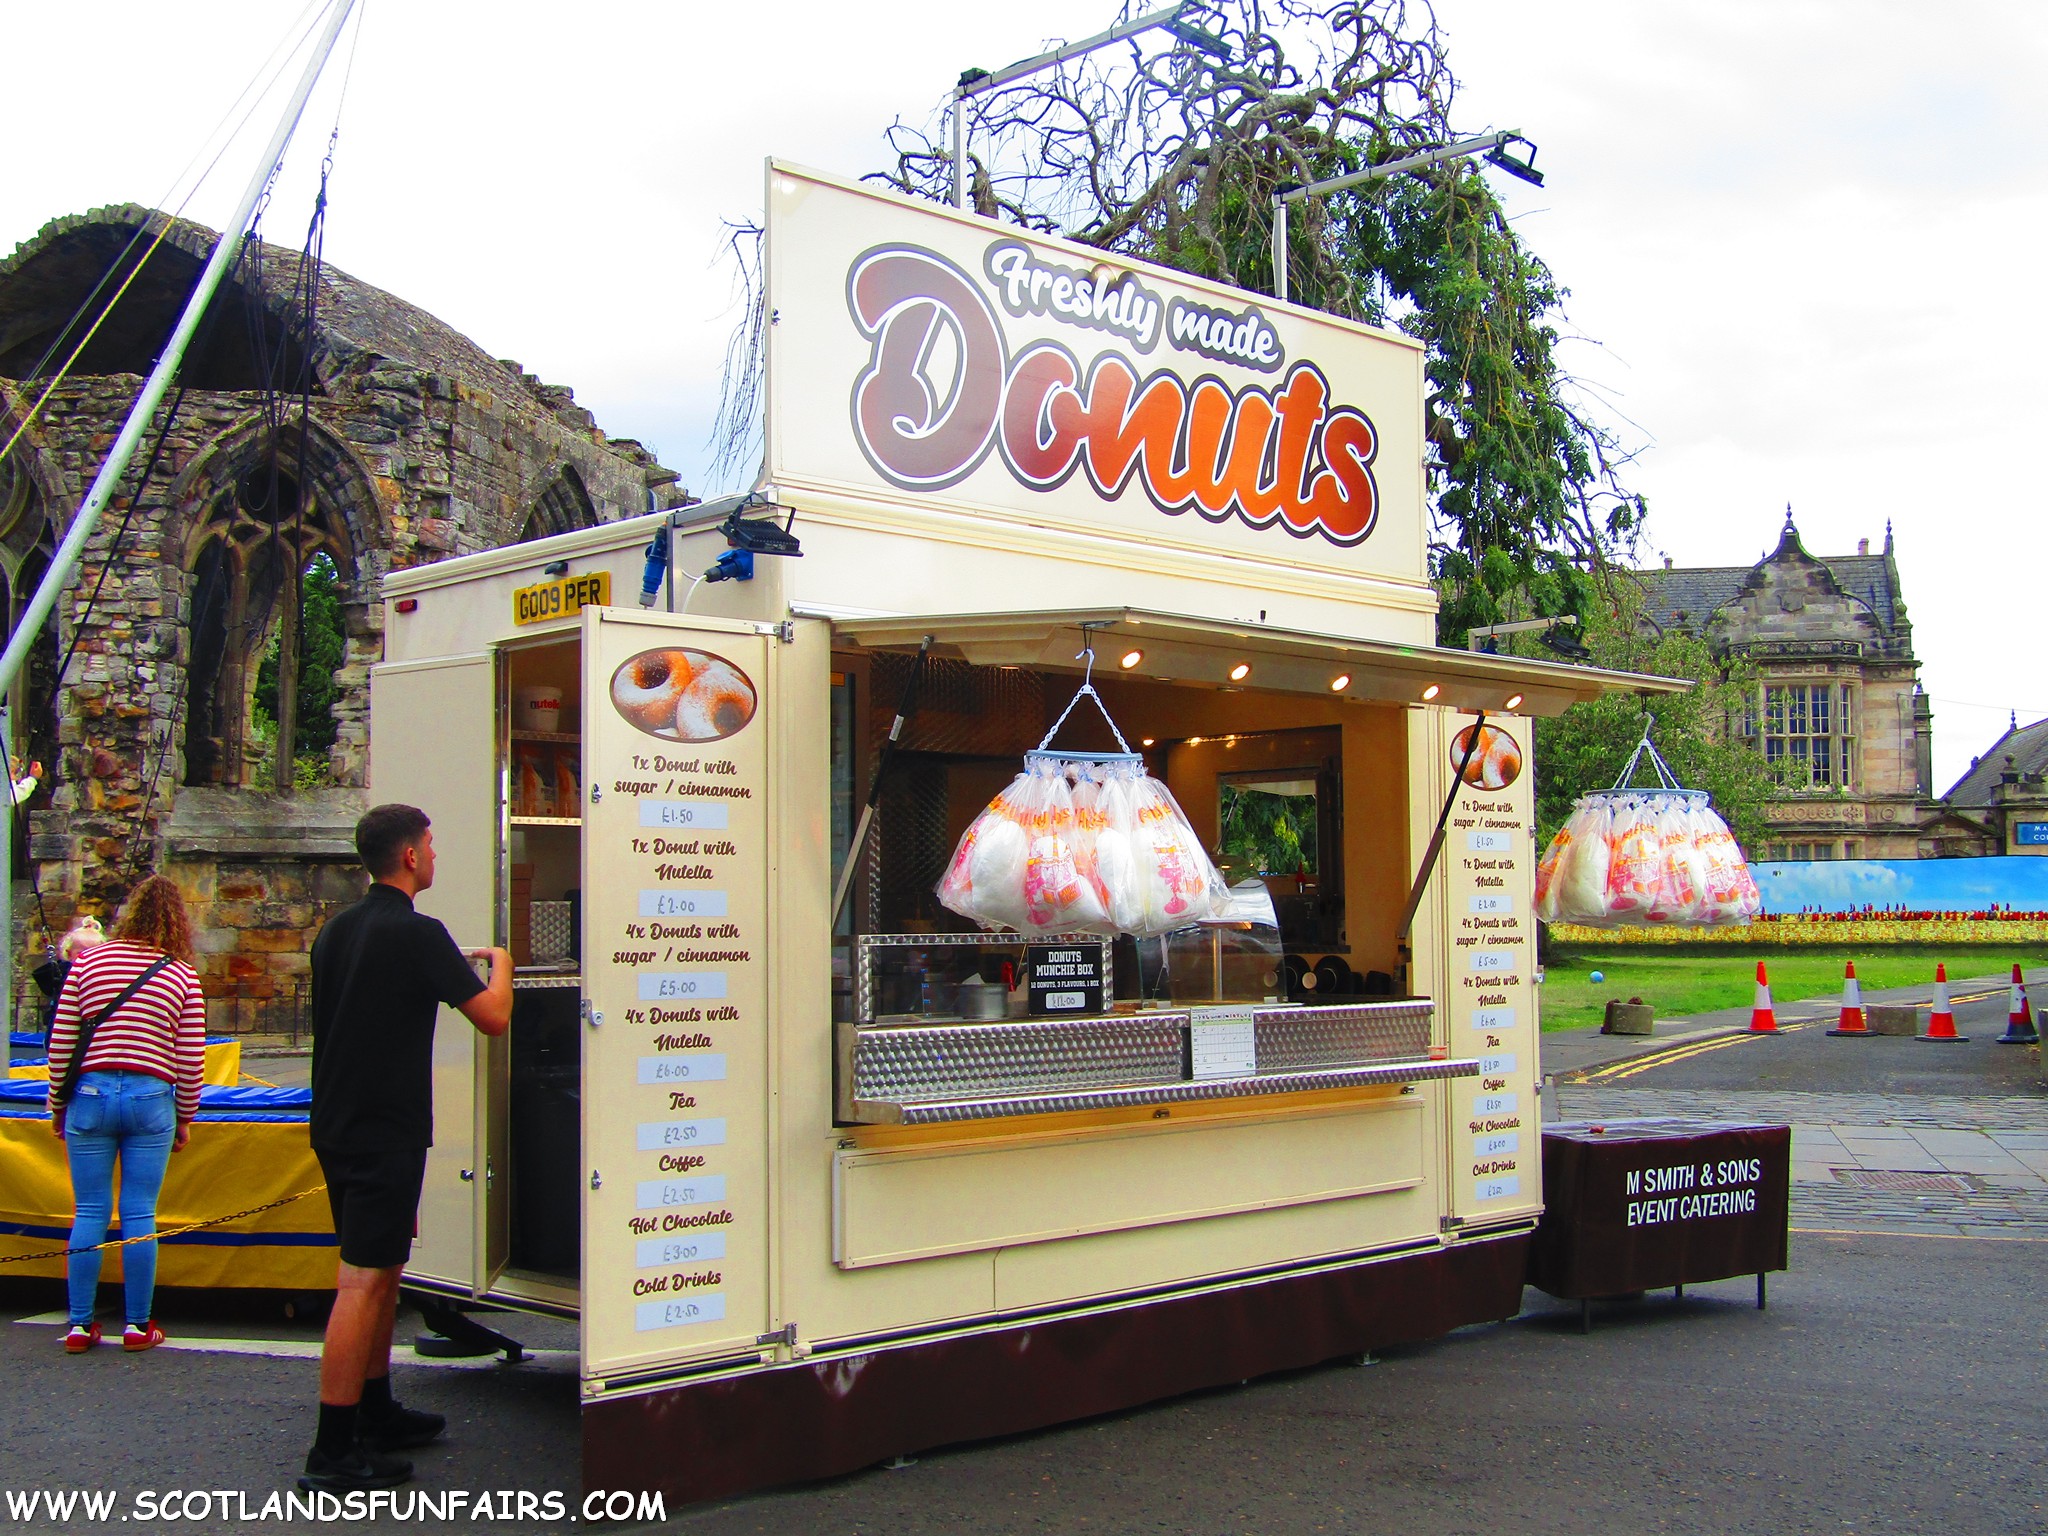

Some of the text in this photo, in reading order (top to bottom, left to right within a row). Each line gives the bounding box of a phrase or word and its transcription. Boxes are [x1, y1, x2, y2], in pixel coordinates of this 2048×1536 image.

[992, 247, 1280, 364] Freshly made
[850, 246, 1377, 544] Donuts
[565, 579, 601, 611] PER
[632, 755, 737, 776] 1x Donut with
[613, 780, 752, 799] sugar / cinnamon
[661, 807, 694, 824] £1.50
[1462, 800, 1514, 814] 1x Donut with
[1453, 816, 1522, 830] sugar / cinnamon
[631, 838, 736, 857] 1x Donut with
[1476, 834, 1494, 848] £1.50
[654, 863, 714, 881] Nutella
[1463, 858, 1515, 871] 1x Donut with
[1475, 876, 1504, 888] Nutella
[657, 896, 696, 915] £2.00
[1478, 900, 1497, 910] £2.00
[625, 922, 740, 940] 4x Donuts with
[1462, 916, 1519, 930] 4x Donuts with
[1456, 932, 1525, 946] sugar / cinnamon
[612, 947, 751, 966] sugar / cinnamon
[1048, 951, 1082, 963] DONUTS
[1036, 964, 1094, 977] MUNCHIE BOX
[659, 980, 697, 996] £5.00
[1463, 973, 1520, 988] 4x Donuts with
[1477, 994, 1507, 1007] Nutella
[625, 1004, 740, 1025] 4x Donuts with
[653, 1032, 712, 1051] Nutella
[1486, 1034, 1500, 1048] Tea
[656, 1064, 690, 1079] £6.00
[1482, 1078, 1506, 1092] Coffee
[669, 1092, 696, 1110] Tea
[1469, 1117, 1521, 1134] Hot Chocolate
[664, 1125, 697, 1144] £2.50
[658, 1154, 706, 1173] Coffee
[1472, 1160, 1516, 1177] Cold Drinks
[1626, 1158, 1761, 1195] M SMITH & SONS
[662, 1188, 695, 1205] £2.50
[1627, 1188, 1756, 1227] EVENT CATERING
[628, 1209, 734, 1235] Hot Chocolate
[663, 1246, 698, 1262] £3.00
[633, 1270, 722, 1296] Cold Drinks
[665, 1304, 700, 1323] £2.50
